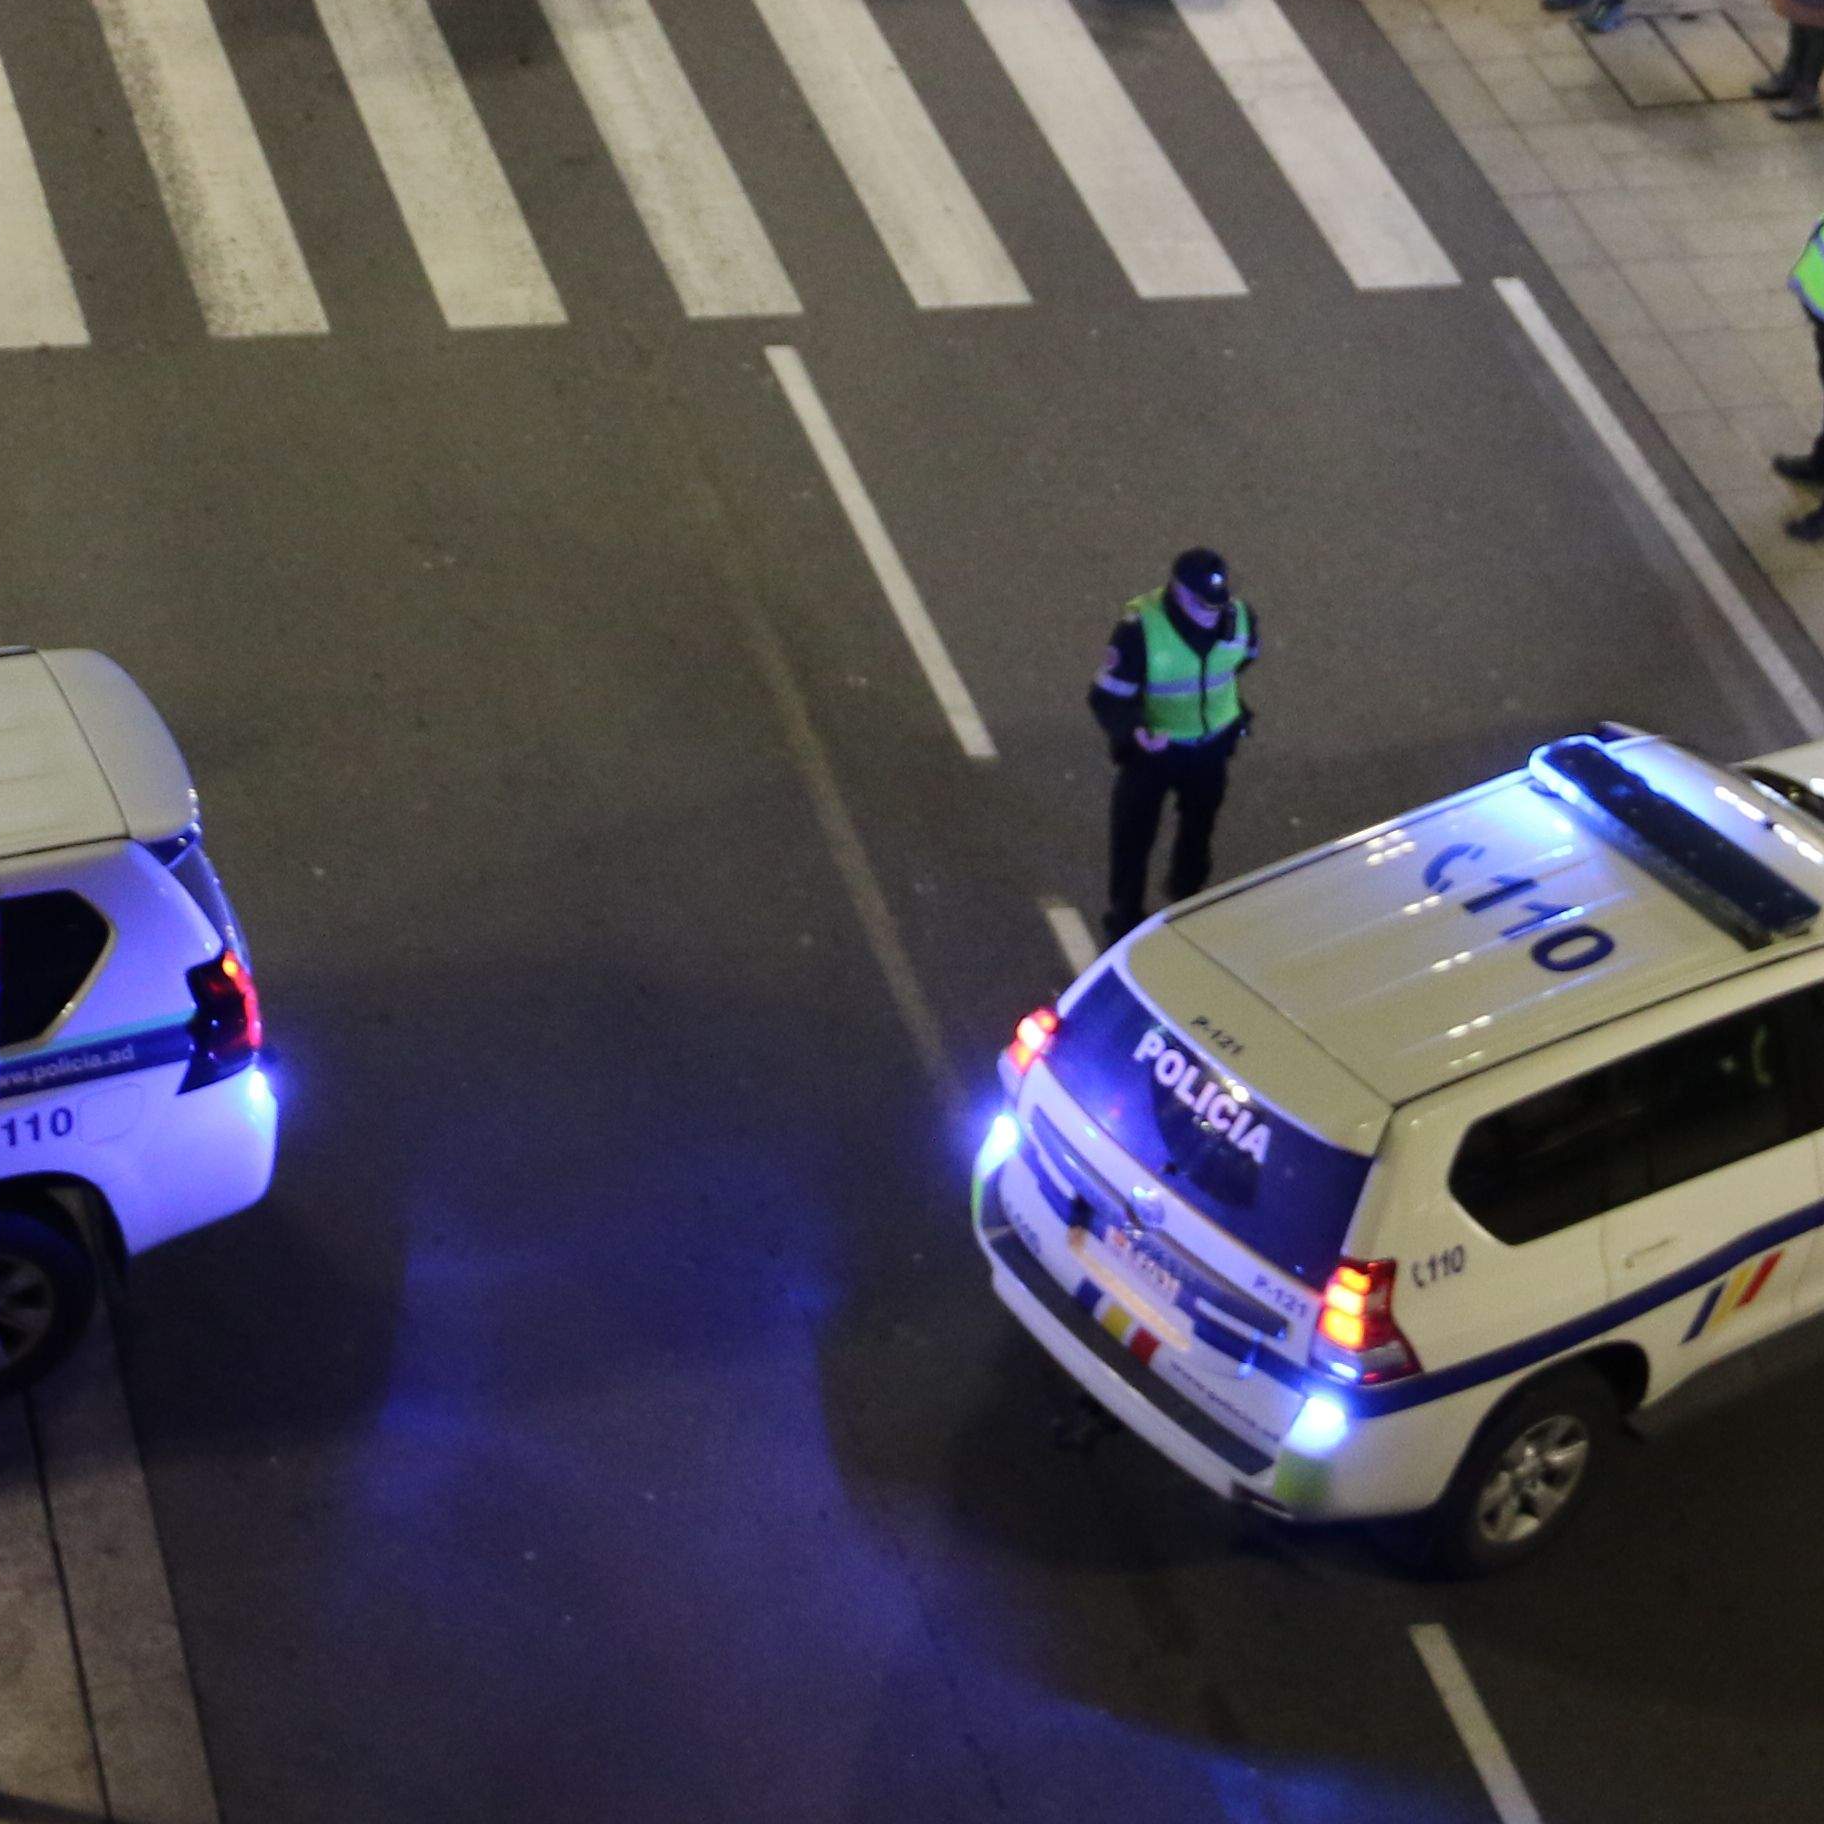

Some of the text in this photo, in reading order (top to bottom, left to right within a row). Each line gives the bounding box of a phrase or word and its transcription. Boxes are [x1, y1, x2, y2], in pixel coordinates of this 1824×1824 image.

[1462, 873, 1615, 973] 110
[0, 1105, 74, 1148] 110
[1132, 1028, 1272, 1164] POLICIA
[1427, 1242, 1466, 1283] 110
